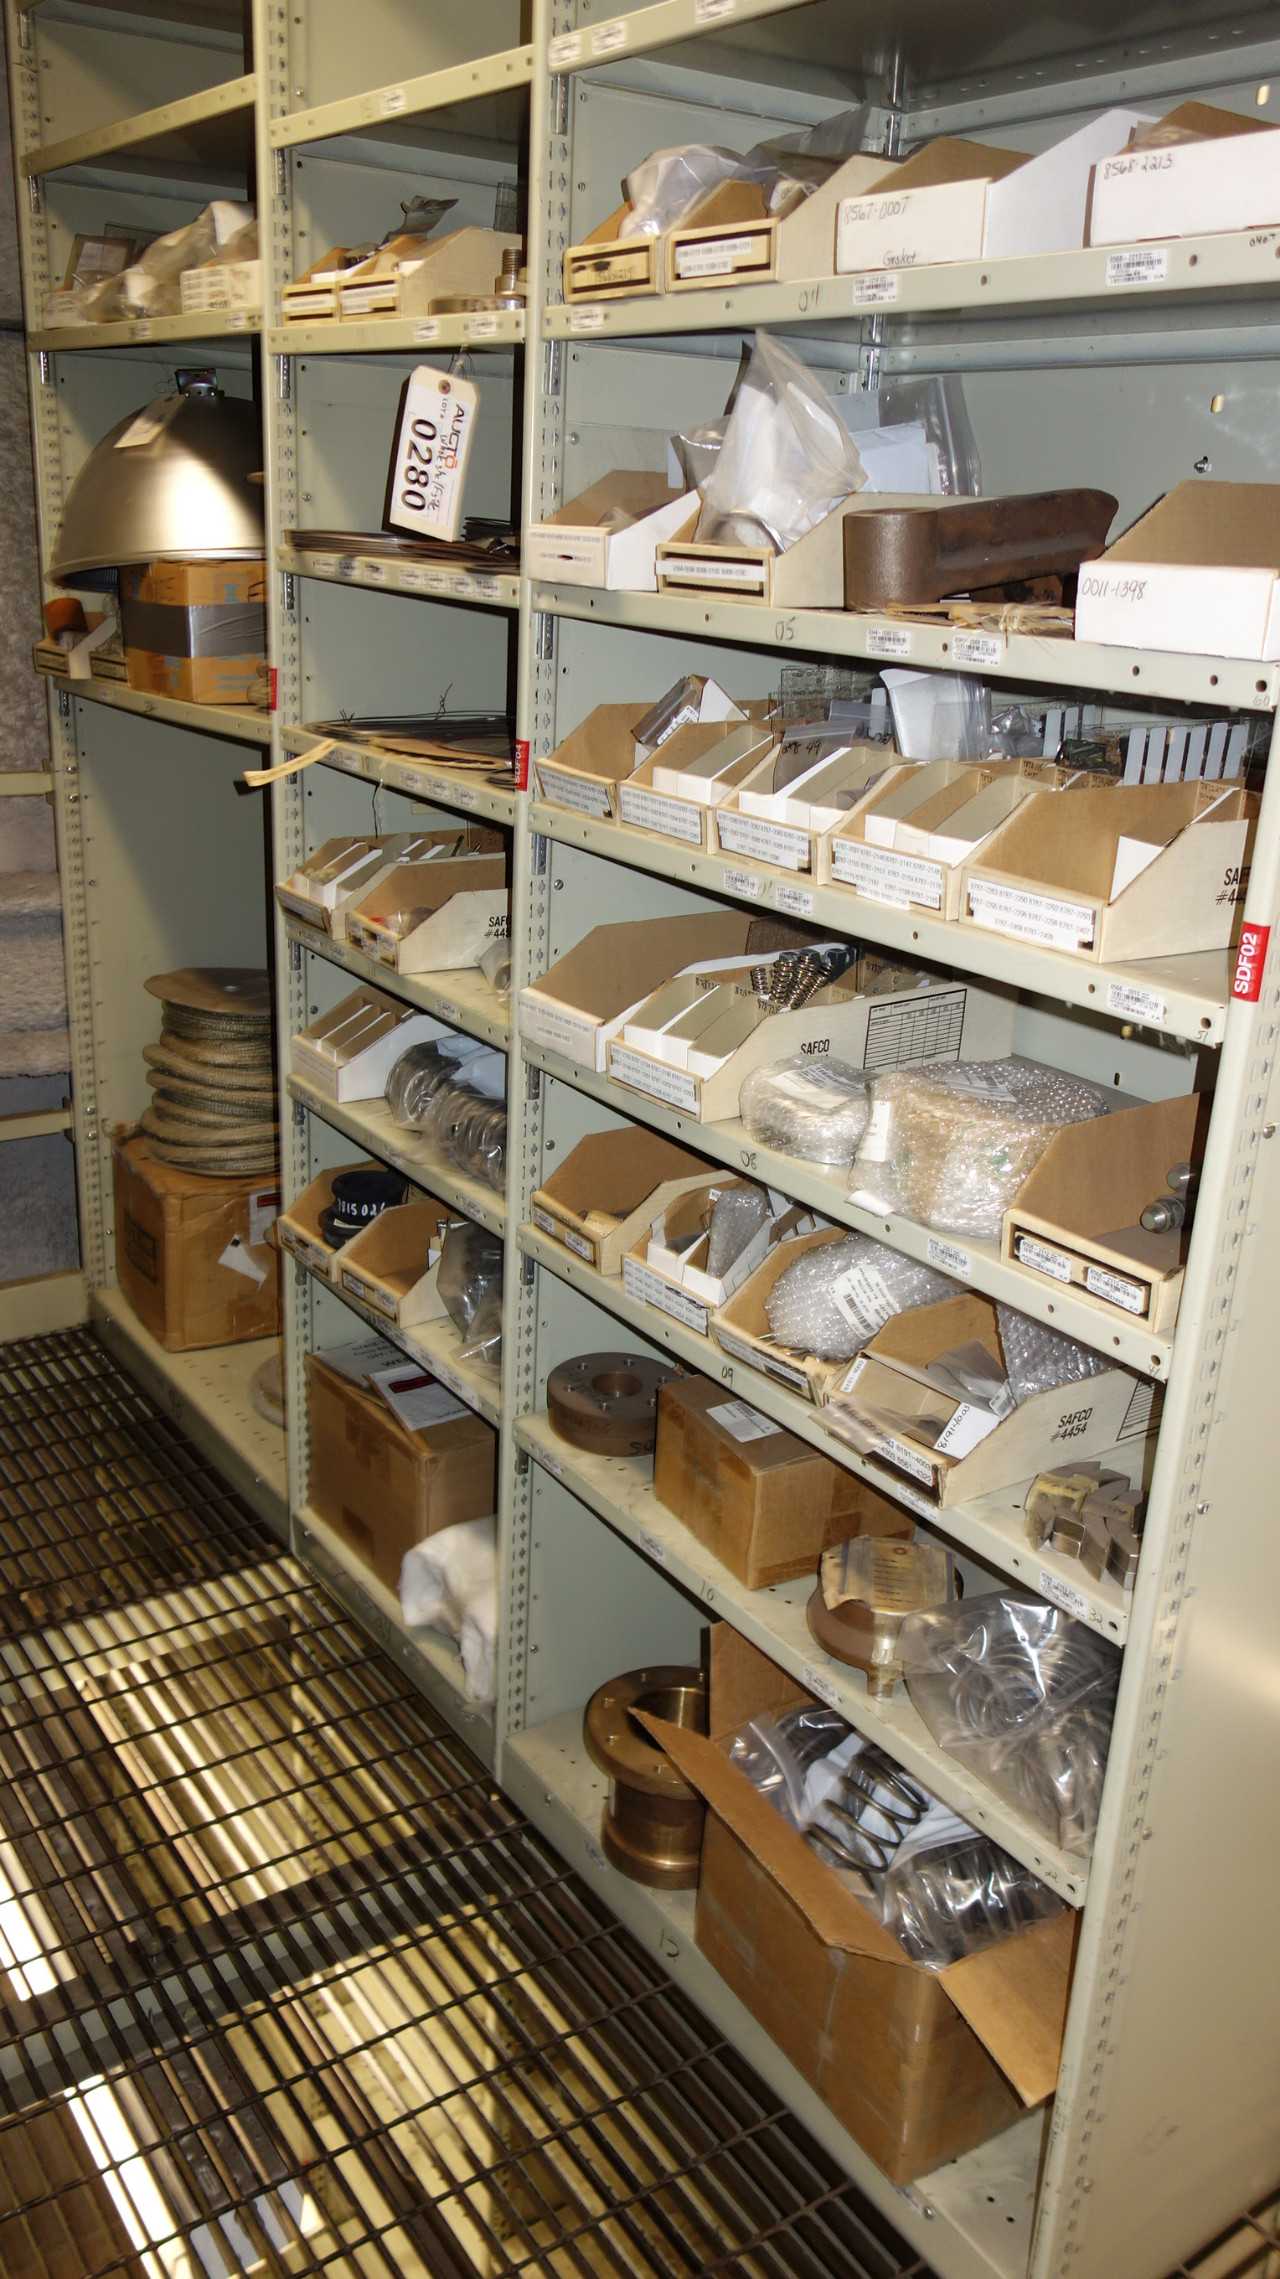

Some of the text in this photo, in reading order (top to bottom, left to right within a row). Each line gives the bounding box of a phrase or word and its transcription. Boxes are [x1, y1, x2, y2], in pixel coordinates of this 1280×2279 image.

[401, 418, 437, 512] 0280
[775, 615, 798, 642] 05
[1224, 866, 1252, 886] SAF
[1233, 931, 1258, 995] SDF02
[800, 1038, 831, 1056] SAFCO
[721, 1366, 735, 1387] 09
[1058, 1407, 1094, 1429] SAFCO
[1050, 1421, 1088, 1442] #4454
